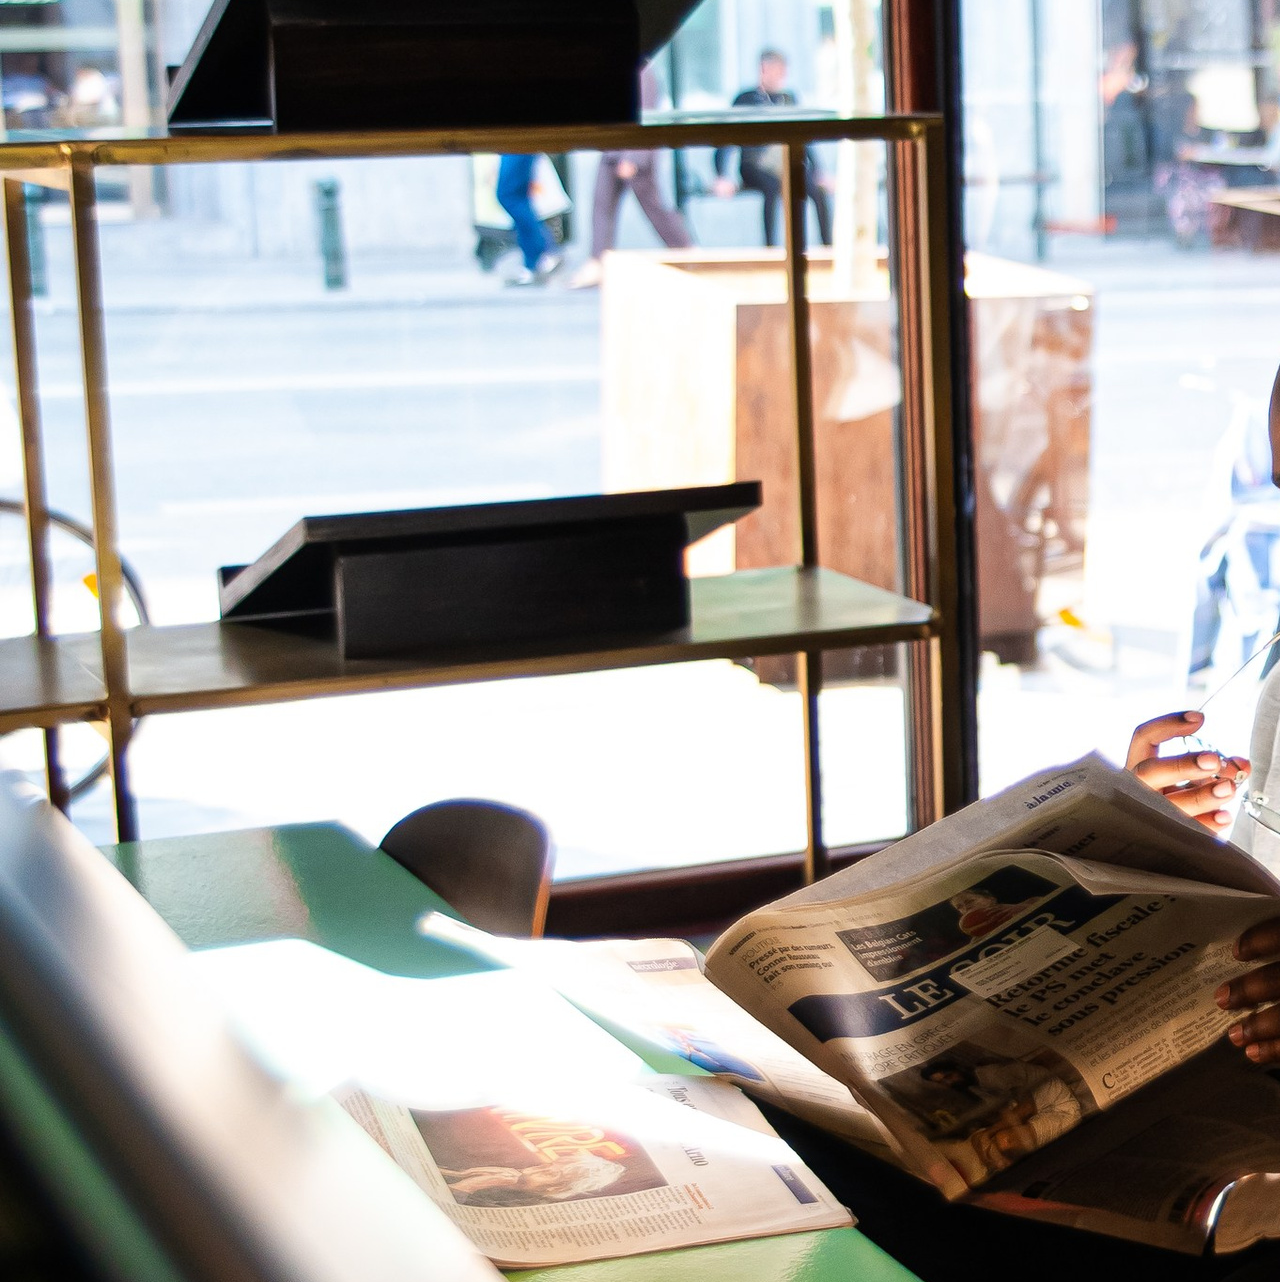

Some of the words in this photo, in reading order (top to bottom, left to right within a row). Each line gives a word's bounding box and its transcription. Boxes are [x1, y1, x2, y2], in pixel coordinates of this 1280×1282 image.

[1086, 900, 1165, 948] fiscale
[850, 941, 865, 951] Les
[866, 936, 897, 951] Belgian
[896, 929, 917, 941] Cats
[859, 936, 924, 960] impressionnent
[749, 944, 779, 970] Pressé
[778, 945, 791, 955] par
[792, 943, 805, 953] des
[757, 953, 787, 977] Conner
[787, 952, 820, 962] Rousseau
[763, 968, 782, 985] fait
[782, 962, 796, 974] son
[795, 961, 823, 971] coming
[823, 960, 834, 968] out
[1003, 1001, 1033, 1018] le
[1030, 979, 1068, 1003] PS
[1068, 950, 1117, 982] met
[878, 979, 955, 1020] LE
[1022, 1010, 1050, 1027] le
[1052, 950, 1149, 1012] conclave
[1047, 1001, 1101, 1037] sous
[1099, 941, 1198, 1006] pression
[1098, 1050, 1111, 1062] les
[1111, 1027, 1151, 1055] allocations
[1151, 1018, 1162, 1030] de
[1124, 1020, 1139, 1034] que
[841, 1046, 895, 1063] NAFRAGE
[895, 1041, 914, 1055] EN
